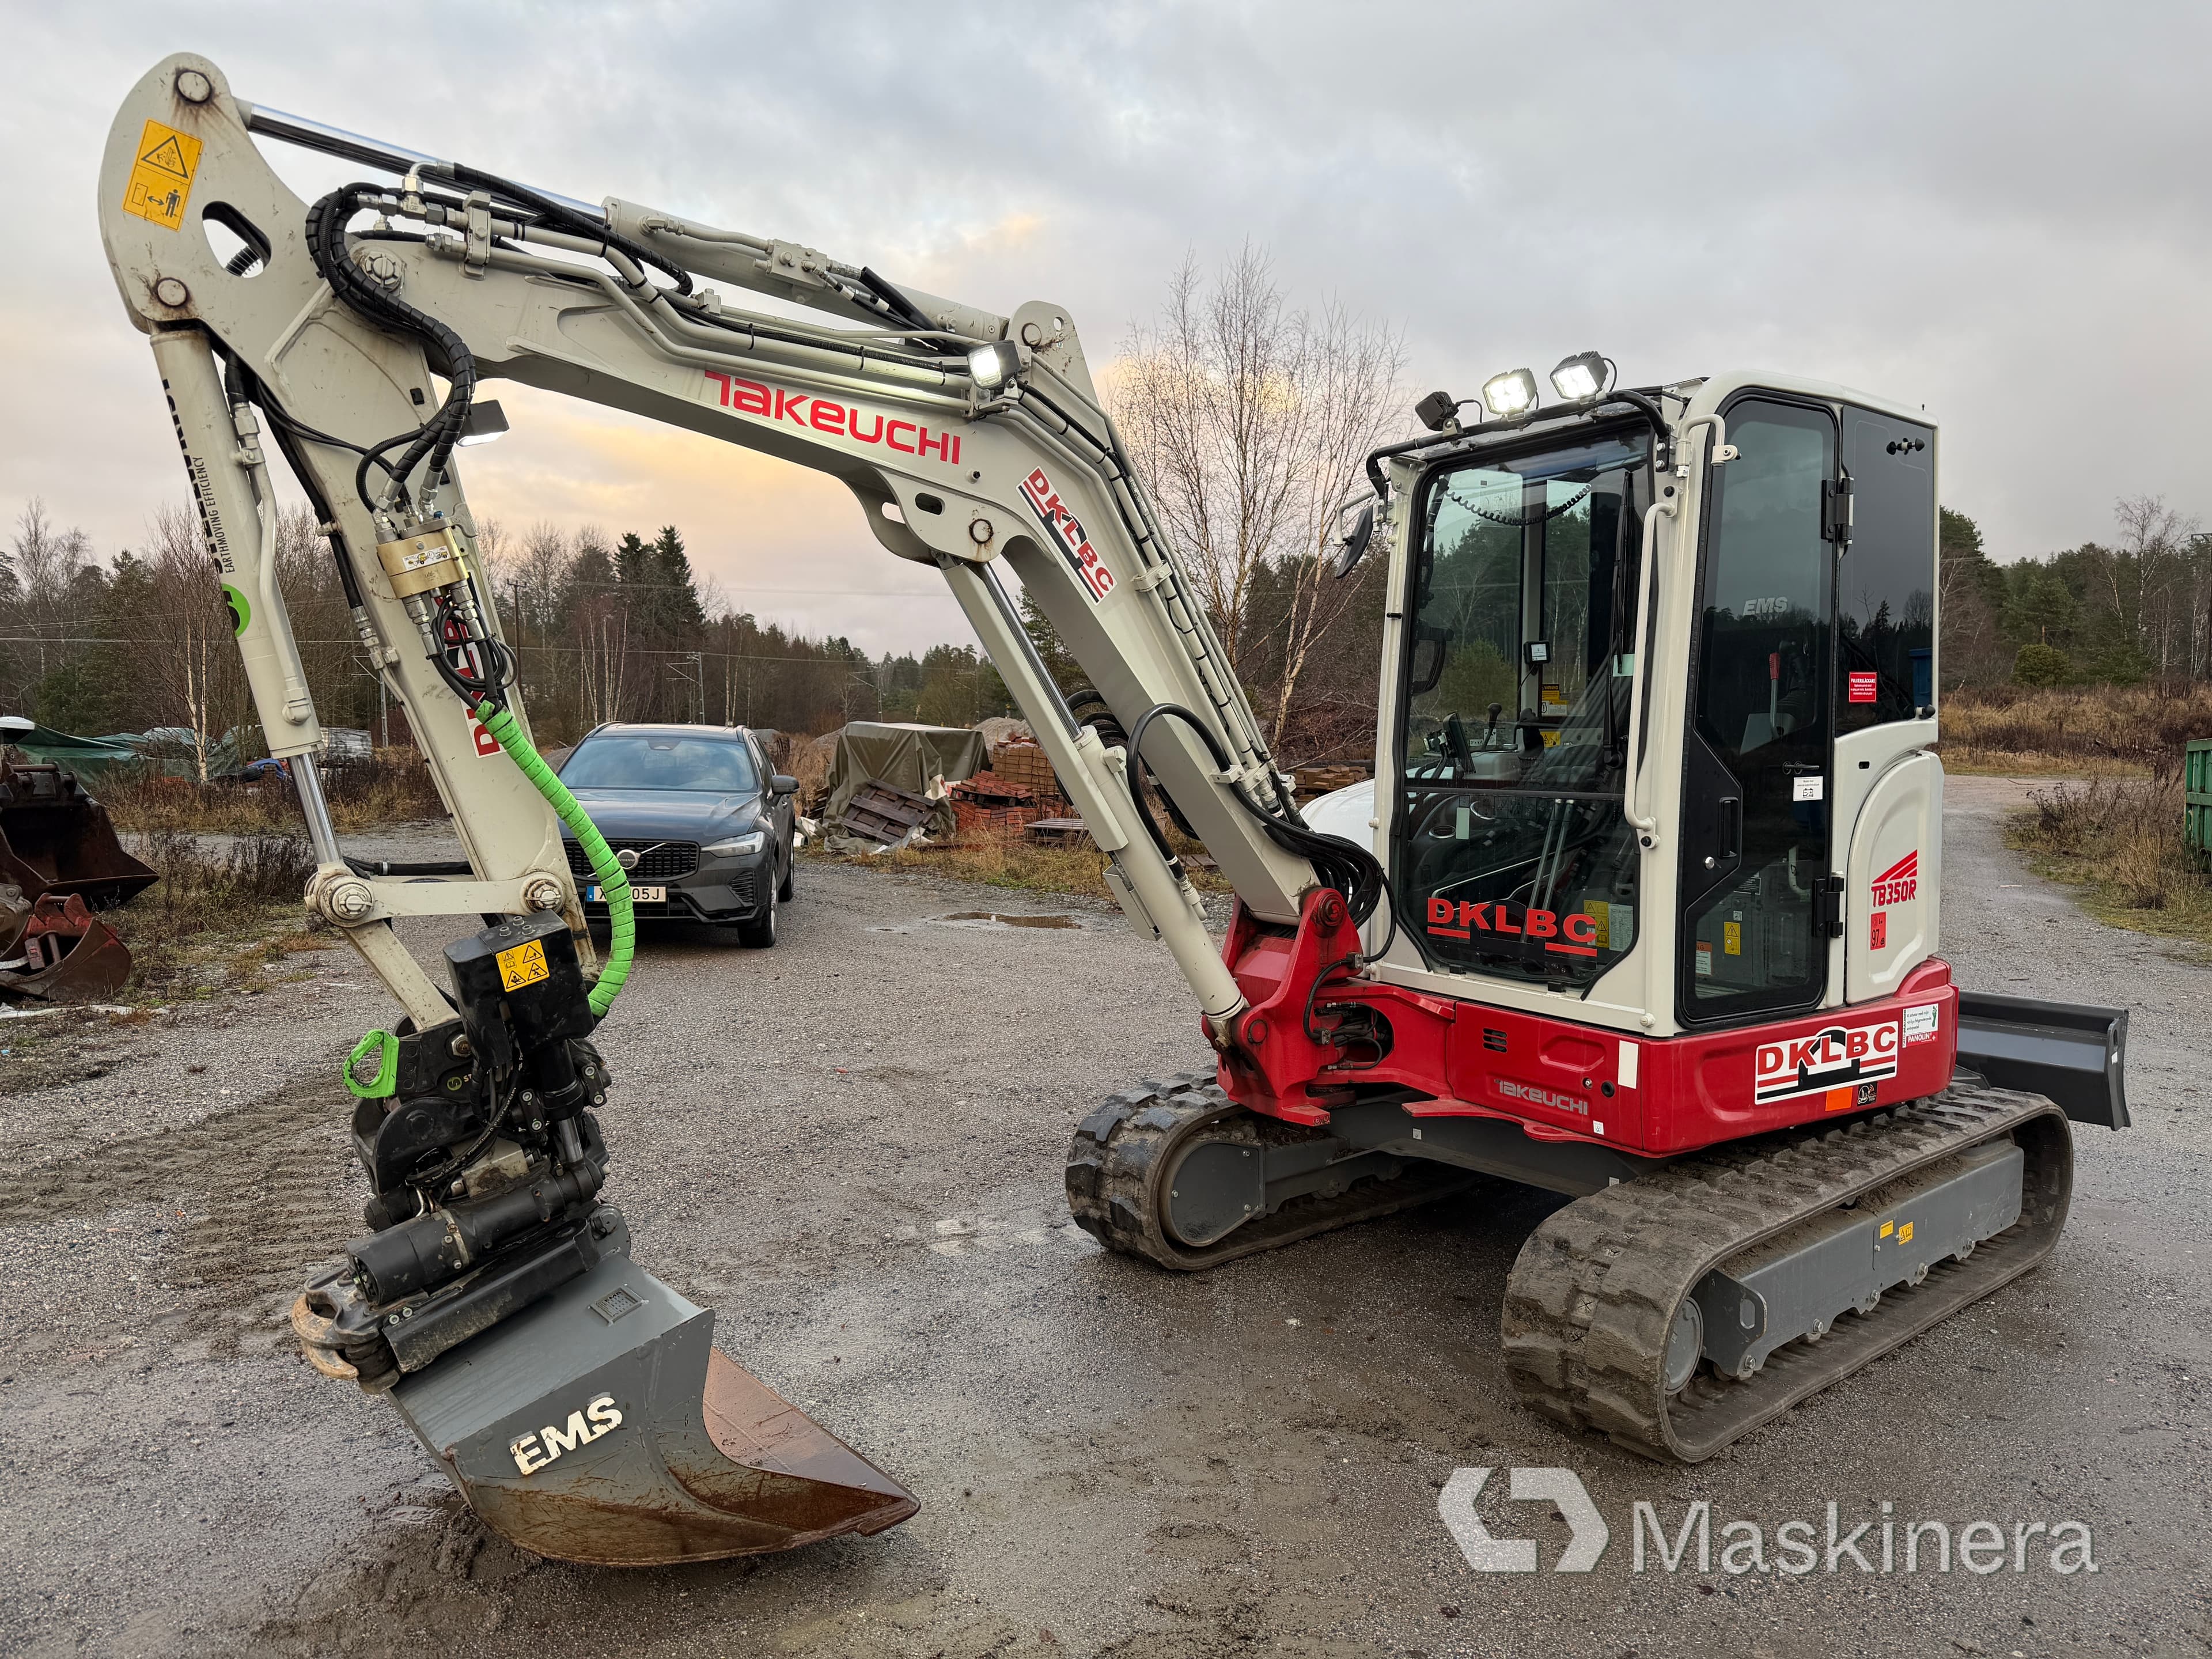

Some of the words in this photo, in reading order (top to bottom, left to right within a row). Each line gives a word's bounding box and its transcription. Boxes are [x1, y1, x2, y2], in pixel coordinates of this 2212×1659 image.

[192, 456, 215, 507] EFFICIENCY
[210, 510, 236, 573] EARTHMOVING
[1028, 467, 1113, 592] DKLBC
[1743, 597, 1787, 616] EMS
[1871, 879, 1917, 908] TB350R
[1427, 897, 1597, 942] DKLBC
[1872, 929, 1880, 946] 97
[1758, 1025, 1896, 1075] DKLBC
[509, 1397, 623, 1475] EMS
